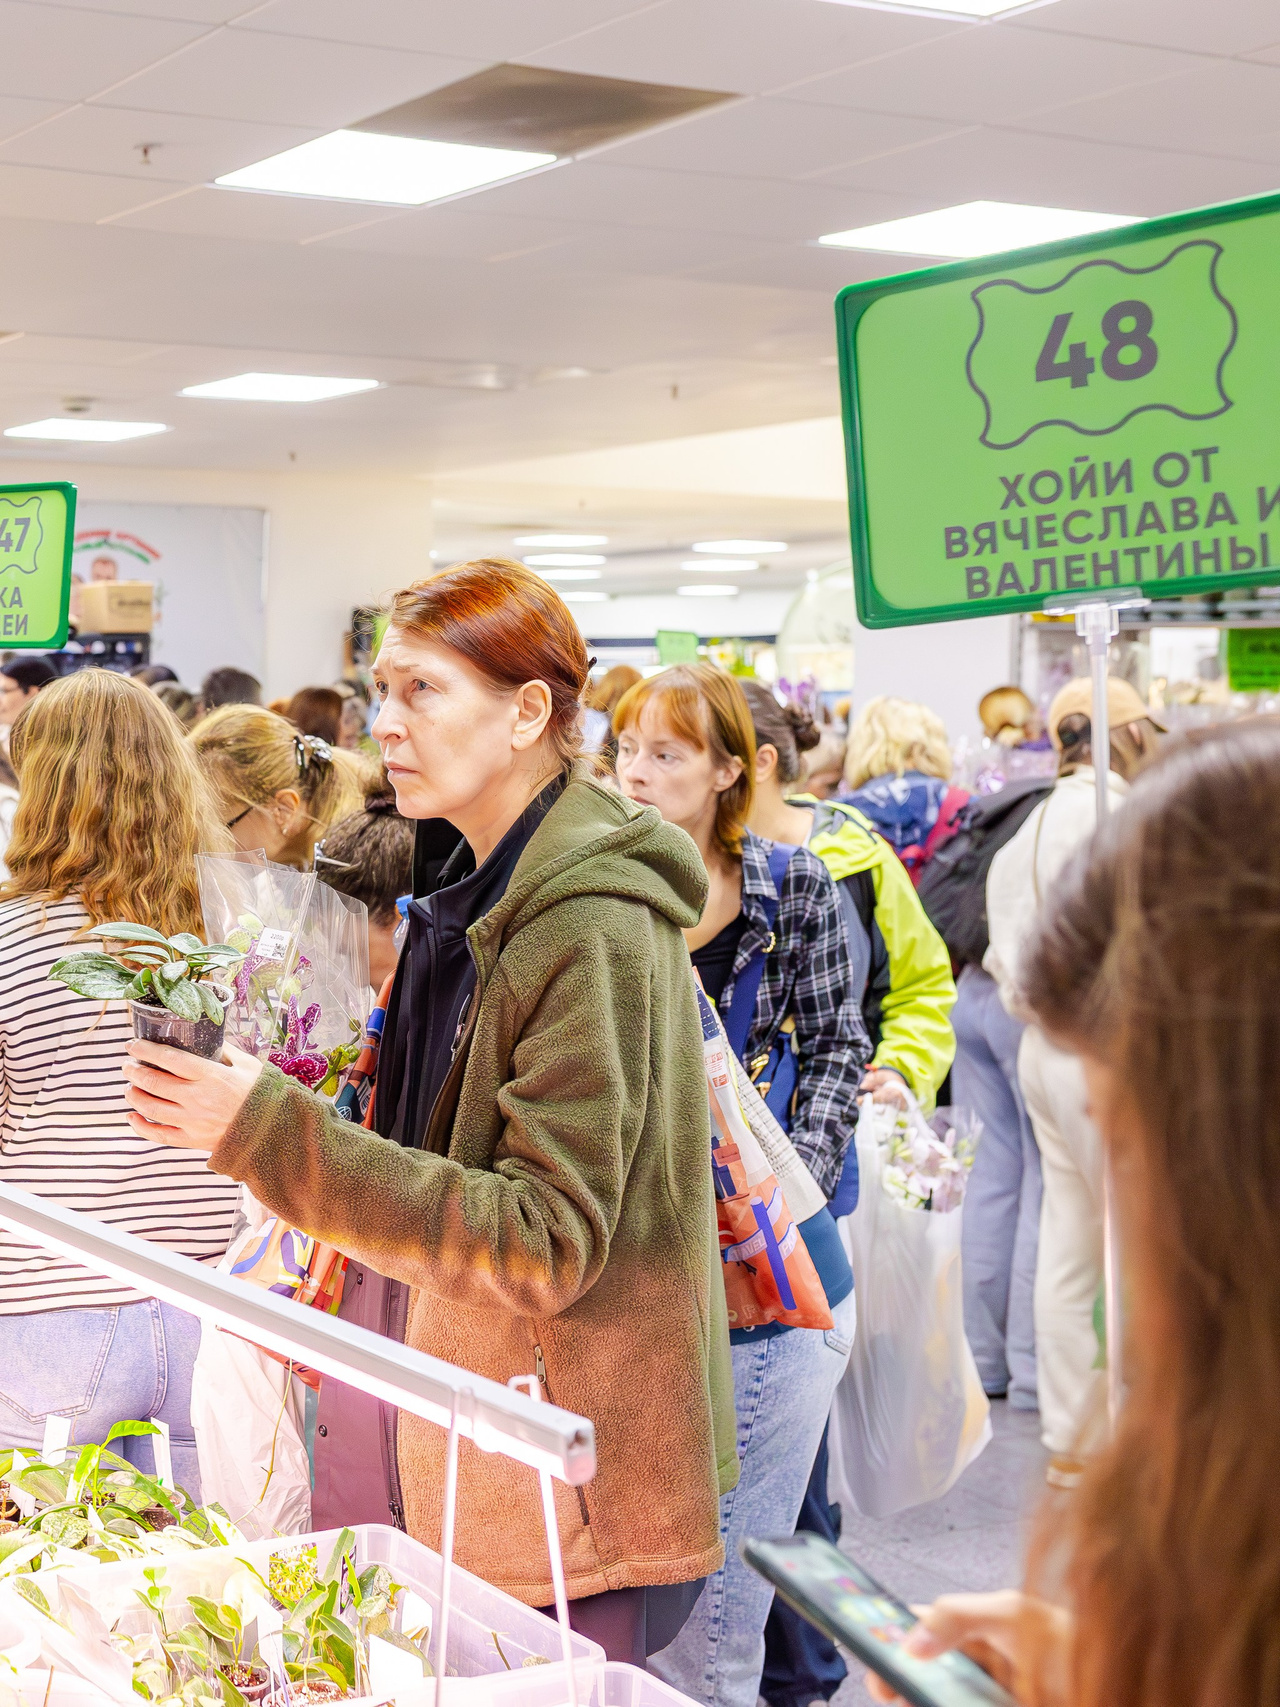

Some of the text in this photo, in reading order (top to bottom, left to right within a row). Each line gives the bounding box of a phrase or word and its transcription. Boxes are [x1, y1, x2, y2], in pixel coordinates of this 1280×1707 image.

[1035, 299, 1158, 389] 48
[999, 446, 1219, 510] ХОЙИ ОТ
[944, 492, 1239, 560] ВЯЧЕСЛАВА
[965, 532, 1270, 599] ВАЛЕНТИНЫ
